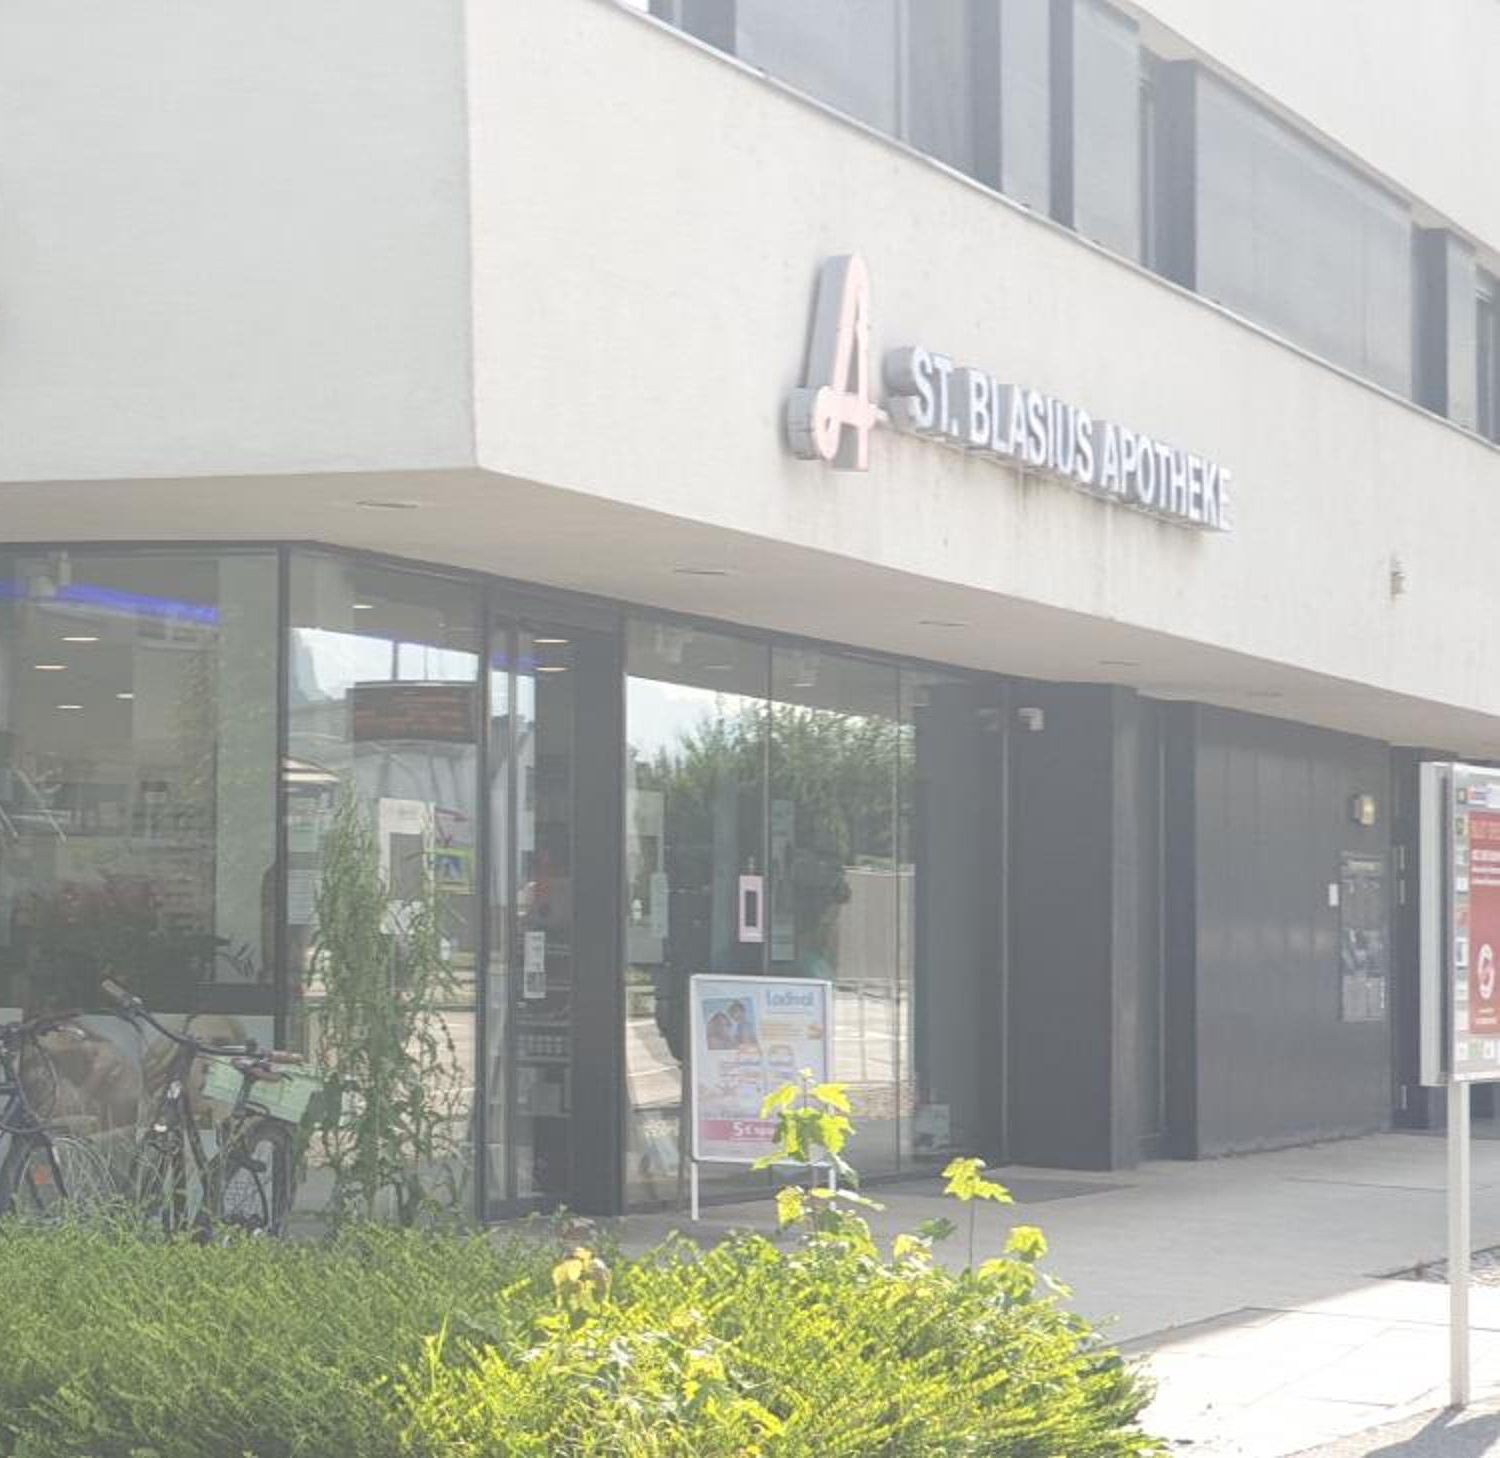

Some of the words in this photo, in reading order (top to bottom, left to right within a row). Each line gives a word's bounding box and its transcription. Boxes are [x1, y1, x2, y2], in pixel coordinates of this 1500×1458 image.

[911, 347, 959, 437] ST.
[968, 368, 1095, 484] BLASIUS
[1100, 423, 1236, 532] APOTHEKE
